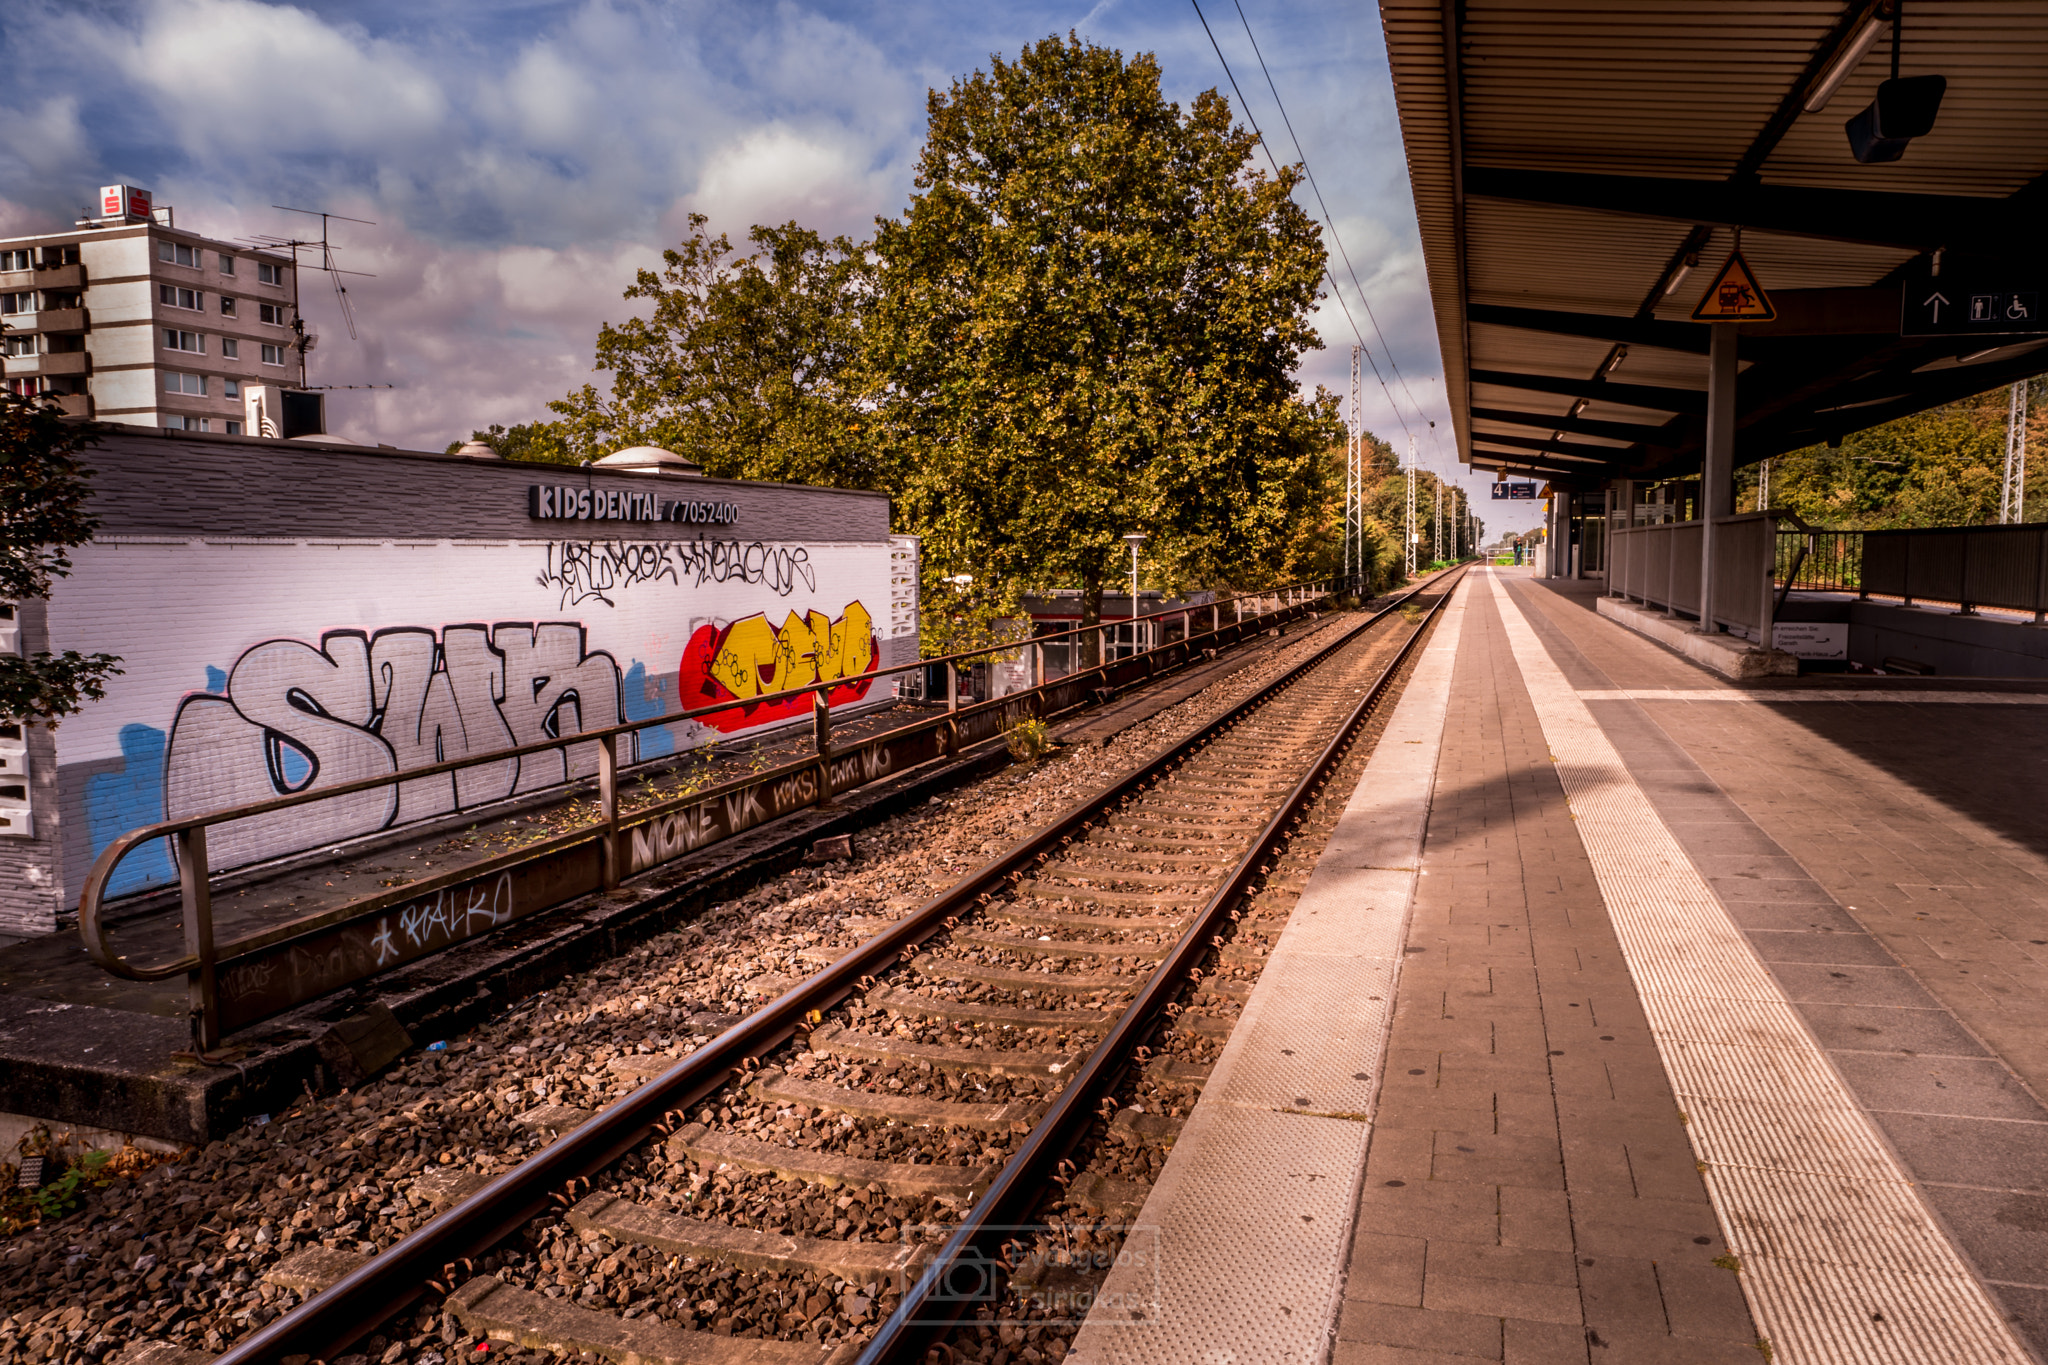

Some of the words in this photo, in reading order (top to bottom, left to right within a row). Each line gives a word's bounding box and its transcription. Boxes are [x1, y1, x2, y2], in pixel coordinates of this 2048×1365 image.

[1493, 483, 1503, 497] 4
[538, 485, 591, 520] KIDS
[594, 489, 662, 521] DENTAL
[681, 501, 739, 523] 7052400
